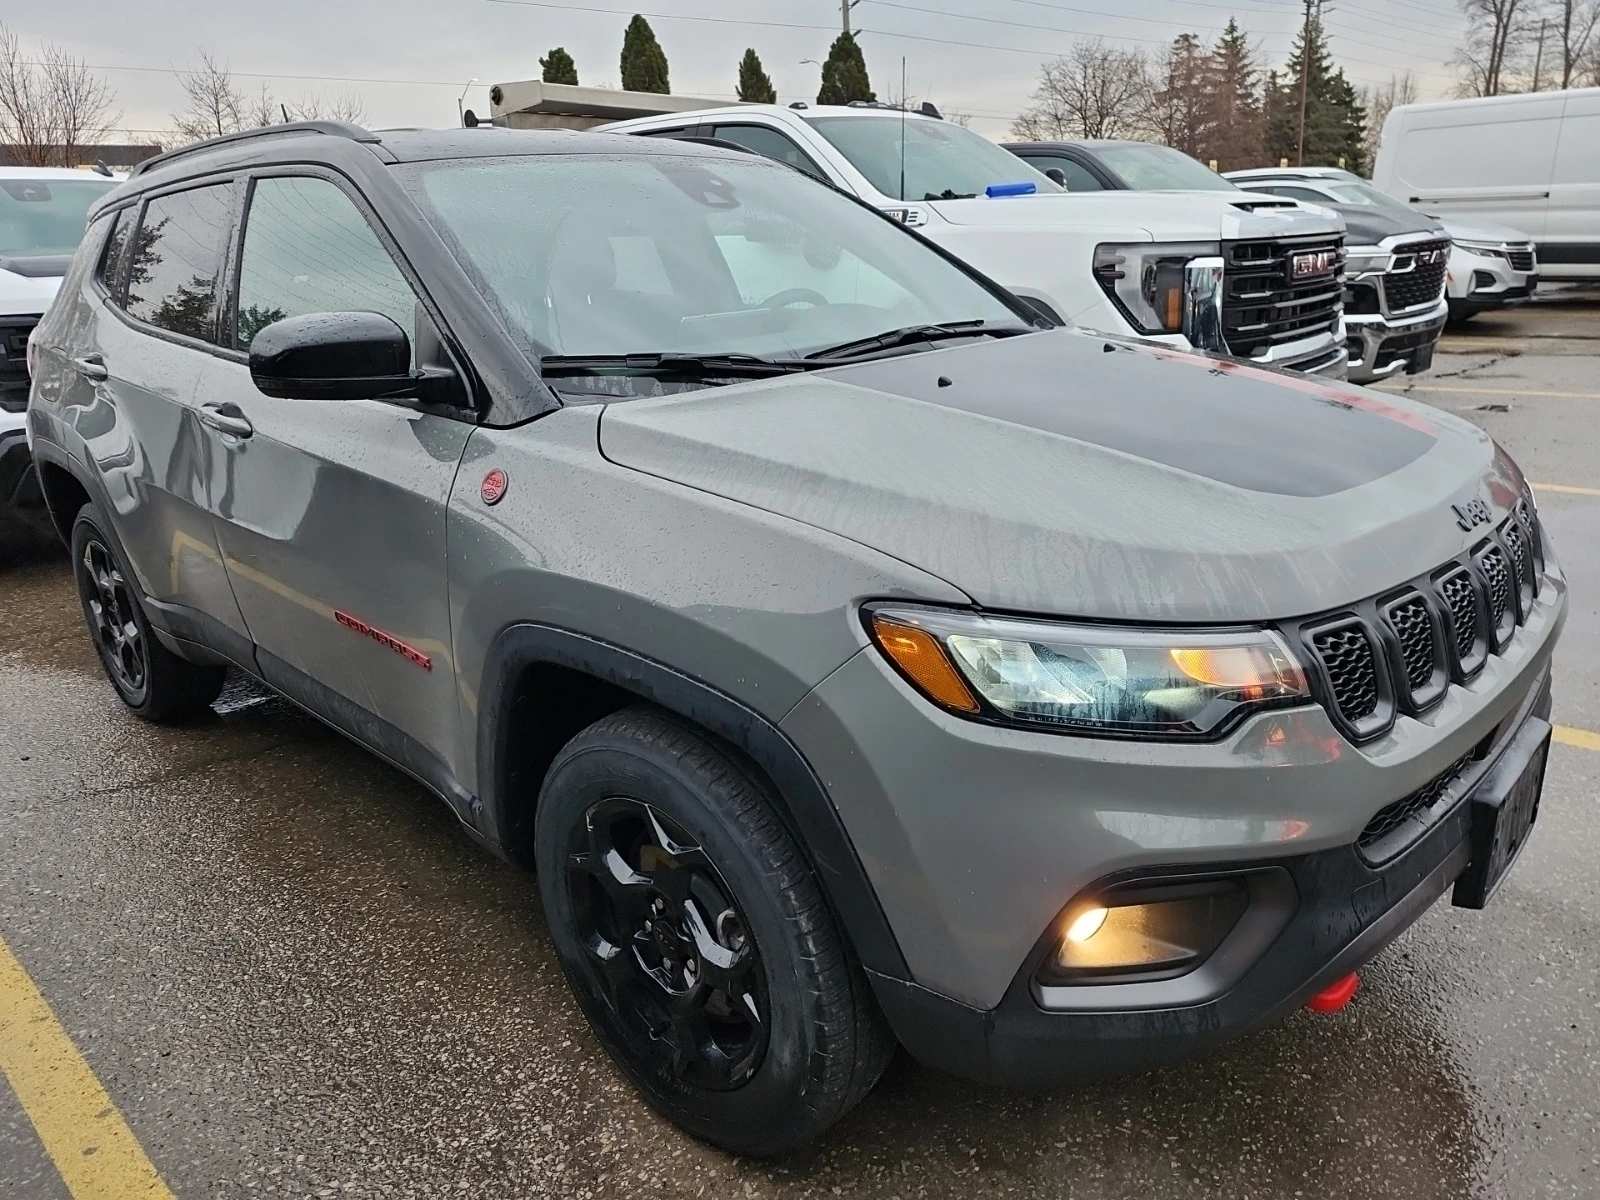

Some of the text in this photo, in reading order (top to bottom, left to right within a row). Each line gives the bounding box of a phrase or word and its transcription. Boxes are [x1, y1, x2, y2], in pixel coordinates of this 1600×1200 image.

[1293, 252, 1336, 278] GMC
[1449, 499, 1492, 532] Jeep
[334, 609, 432, 672] COMPASS
